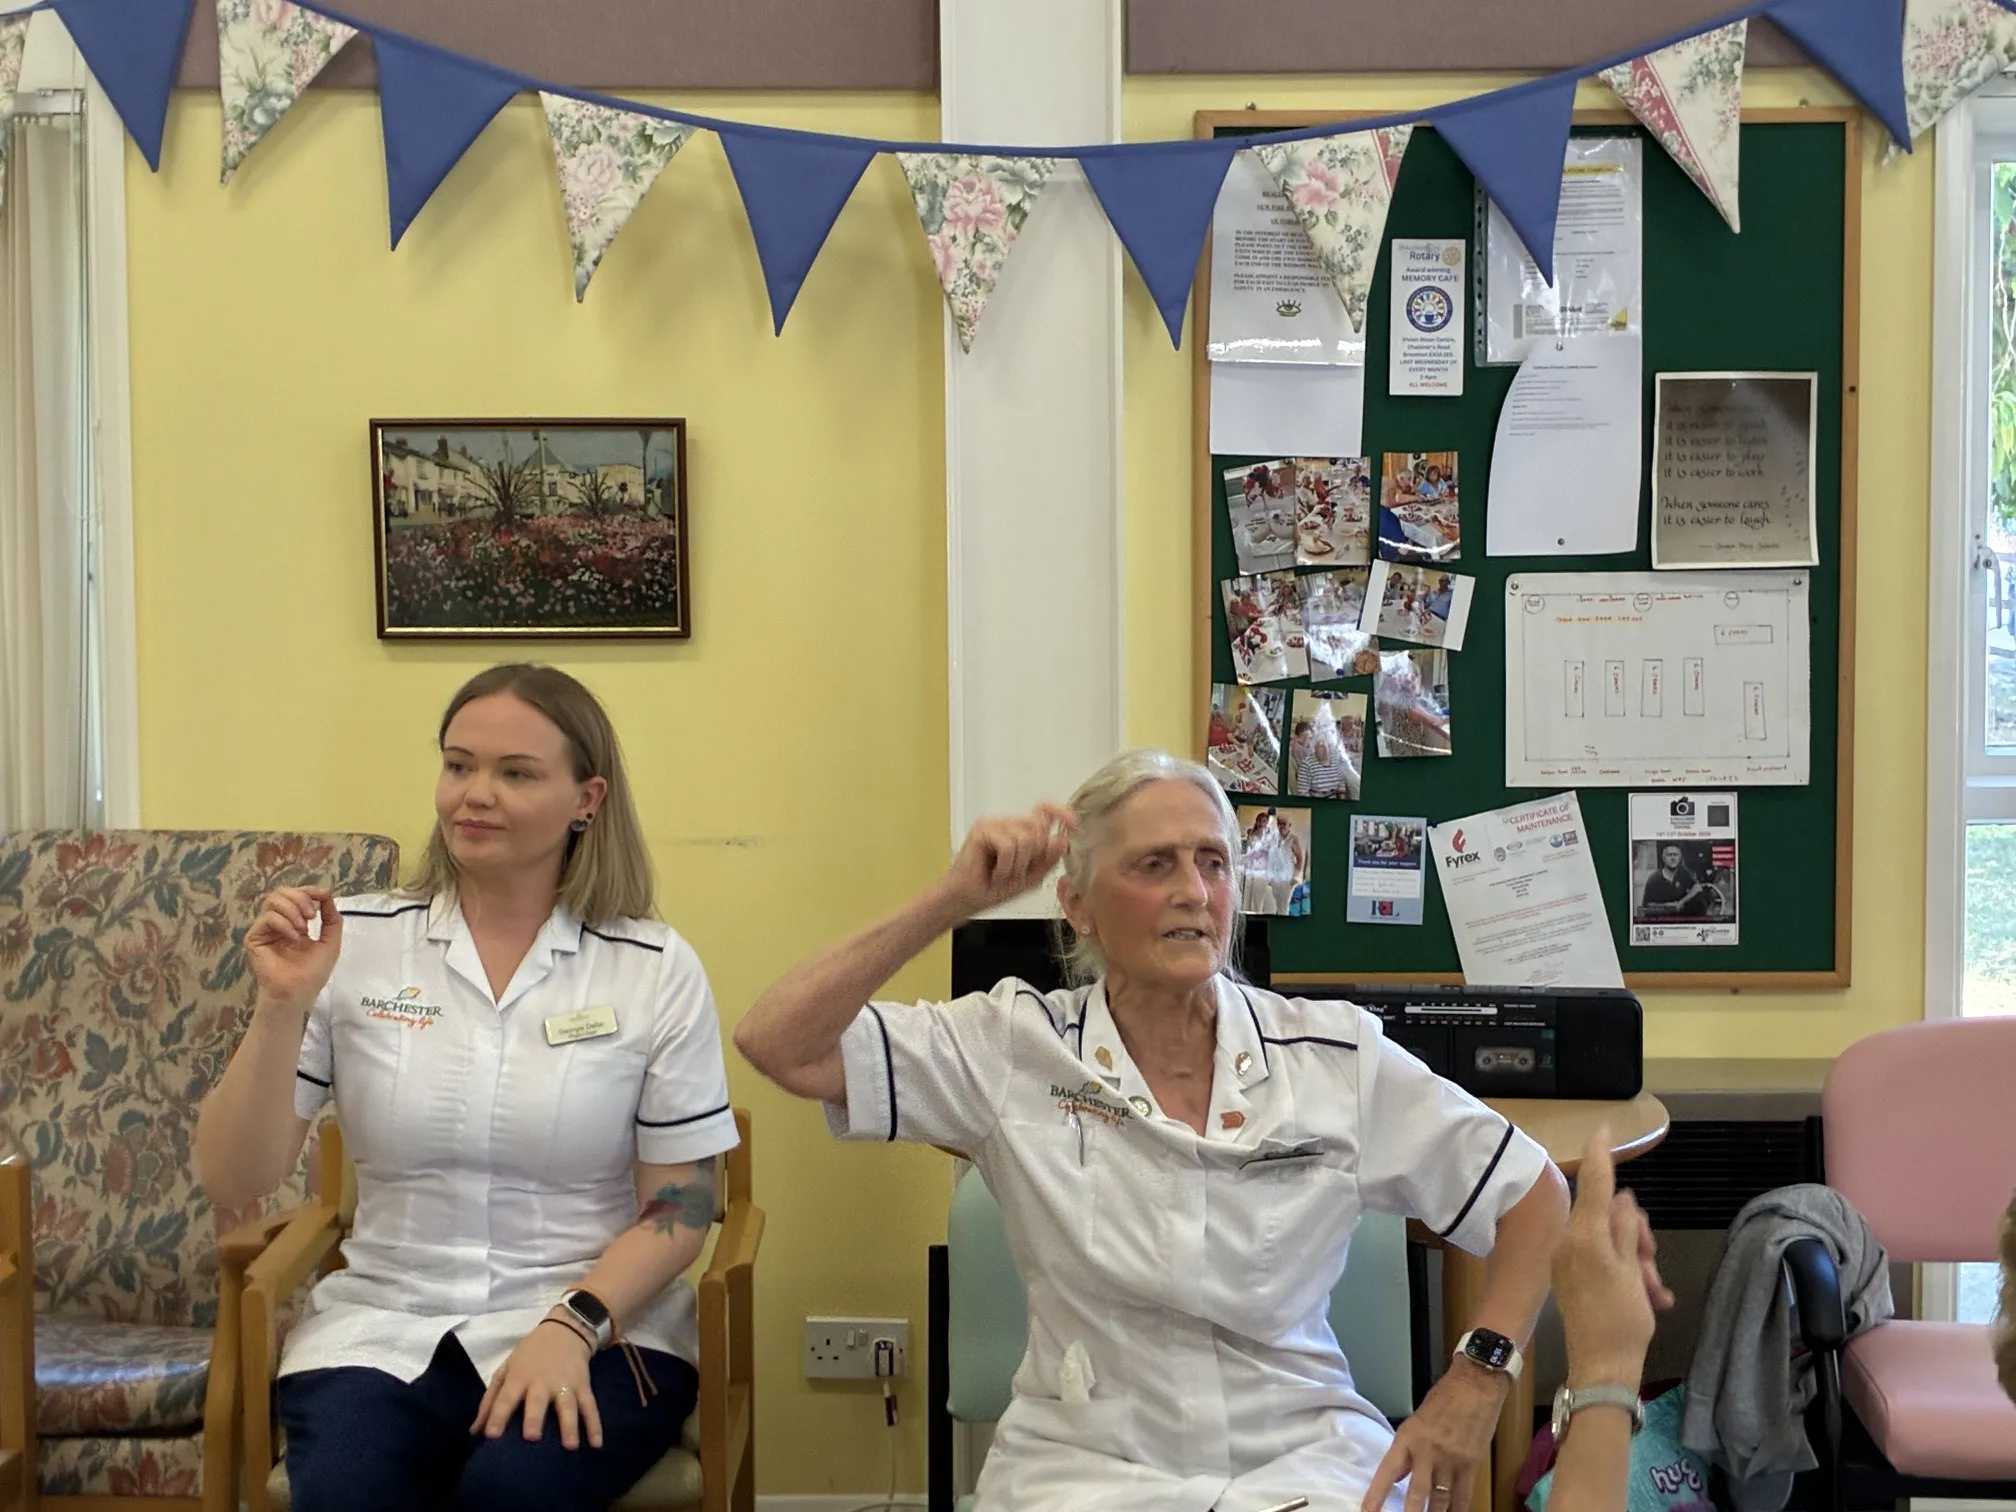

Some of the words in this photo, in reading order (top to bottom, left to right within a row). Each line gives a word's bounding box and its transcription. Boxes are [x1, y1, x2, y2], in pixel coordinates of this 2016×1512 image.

[1409, 251, 1440, 262] Rotary
[1690, 436, 1720, 446] easier
[1664, 451, 1673, 461] it
[1676, 453, 1687, 463] is
[1690, 453, 1720, 462] easier
[1726, 452, 1736, 461] to
[1676, 468, 1687, 478] is
[1690, 468, 1722, 478] easier
[1726, 468, 1736, 478] to
[1738, 463, 1765, 478] work
[1661, 496, 1693, 510] When
[1695, 500, 1740, 512] someone
[1742, 500, 1770, 510] cares
[1663, 514, 1672, 525] it
[1676, 516, 1686, 527] is
[1690, 516, 1722, 526] easier
[1724, 514, 1735, 525] to
[1740, 511, 1772, 530] laugh
[1510, 805, 1558, 824] CERTIFICATE
[1559, 802, 1569, 812] OF
[1516, 813, 1574, 833] MAINTENANCE
[1445, 851, 1481, 868] Fyrex
[360, 996, 444, 1017] BARCHESTER
[366, 1008, 417, 1028] Celebrating
[418, 1016, 434, 1030] life
[1650, 1457, 1703, 1494] hug
